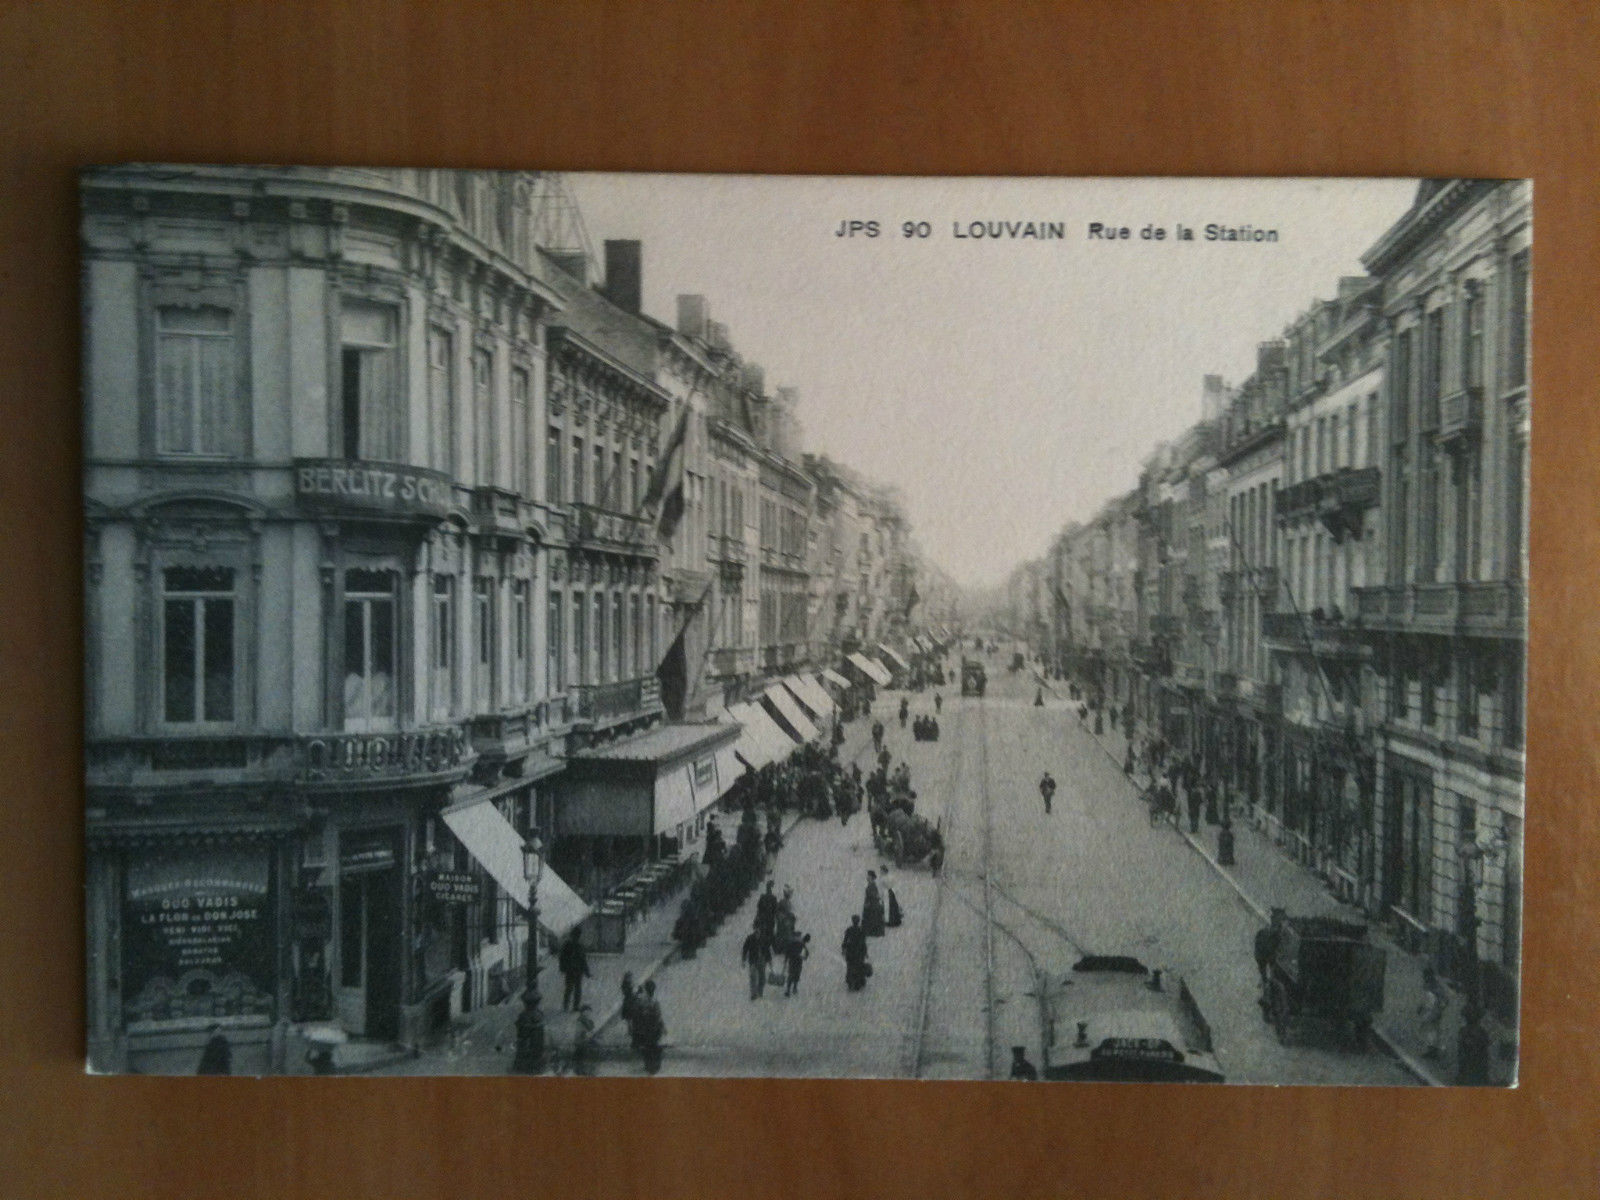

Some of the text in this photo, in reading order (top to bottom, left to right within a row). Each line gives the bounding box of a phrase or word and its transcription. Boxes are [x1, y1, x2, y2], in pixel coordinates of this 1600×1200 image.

[835, 220, 1279, 243] JPS 90 LOUVAIN Rue de la Station
[299, 467, 396, 498] BERLITZ
[438, 873, 473, 883] MAISON
[431, 881, 451, 891] QUO
[161, 896, 239, 910] QUO VADIS
[141, 914, 156, 924] LA
[159, 912, 189, 923] FLOR
[204, 911, 228, 921] DON
